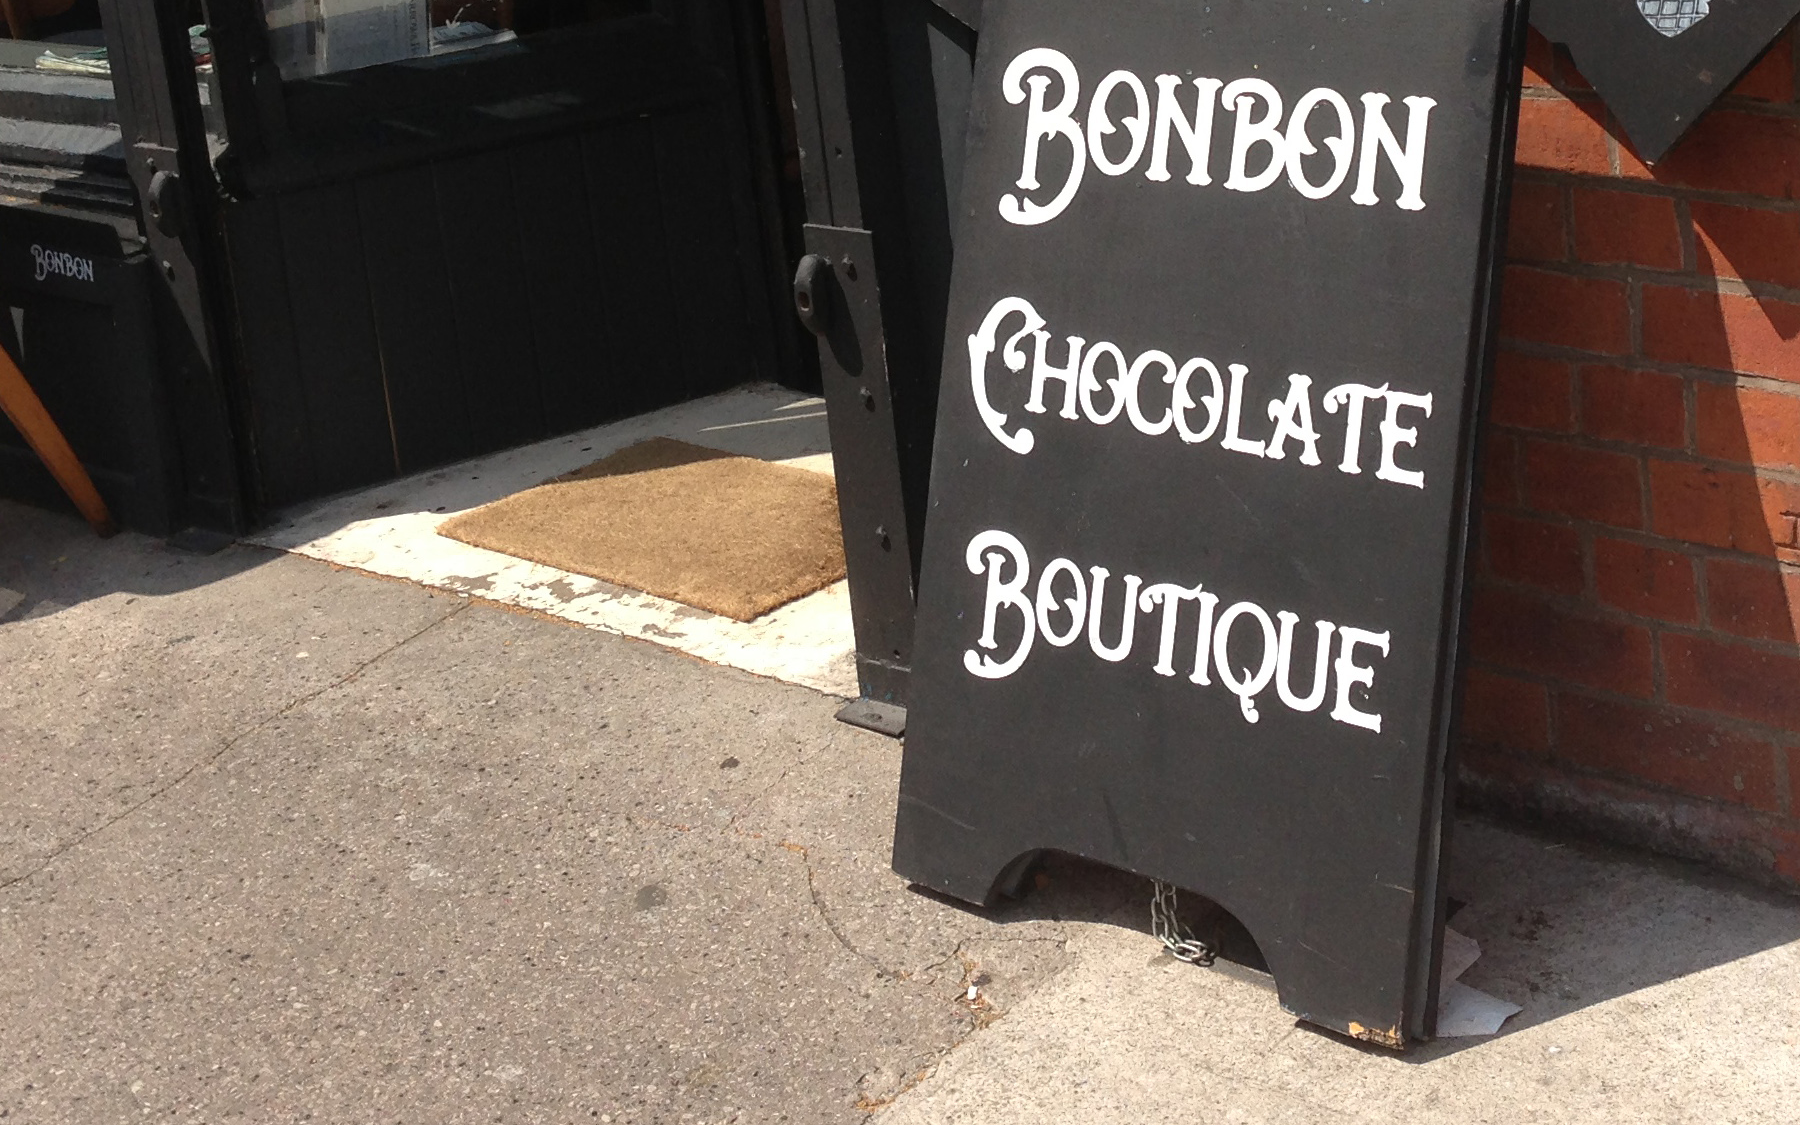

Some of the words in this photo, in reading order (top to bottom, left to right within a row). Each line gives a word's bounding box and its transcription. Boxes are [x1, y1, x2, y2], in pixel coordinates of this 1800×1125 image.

[998, 47, 1438, 226] BONBON
[30, 243, 95, 283] BONBON
[967, 296, 1434, 490] CHOCOLATE
[964, 529, 1391, 734] BOUTIQUE
